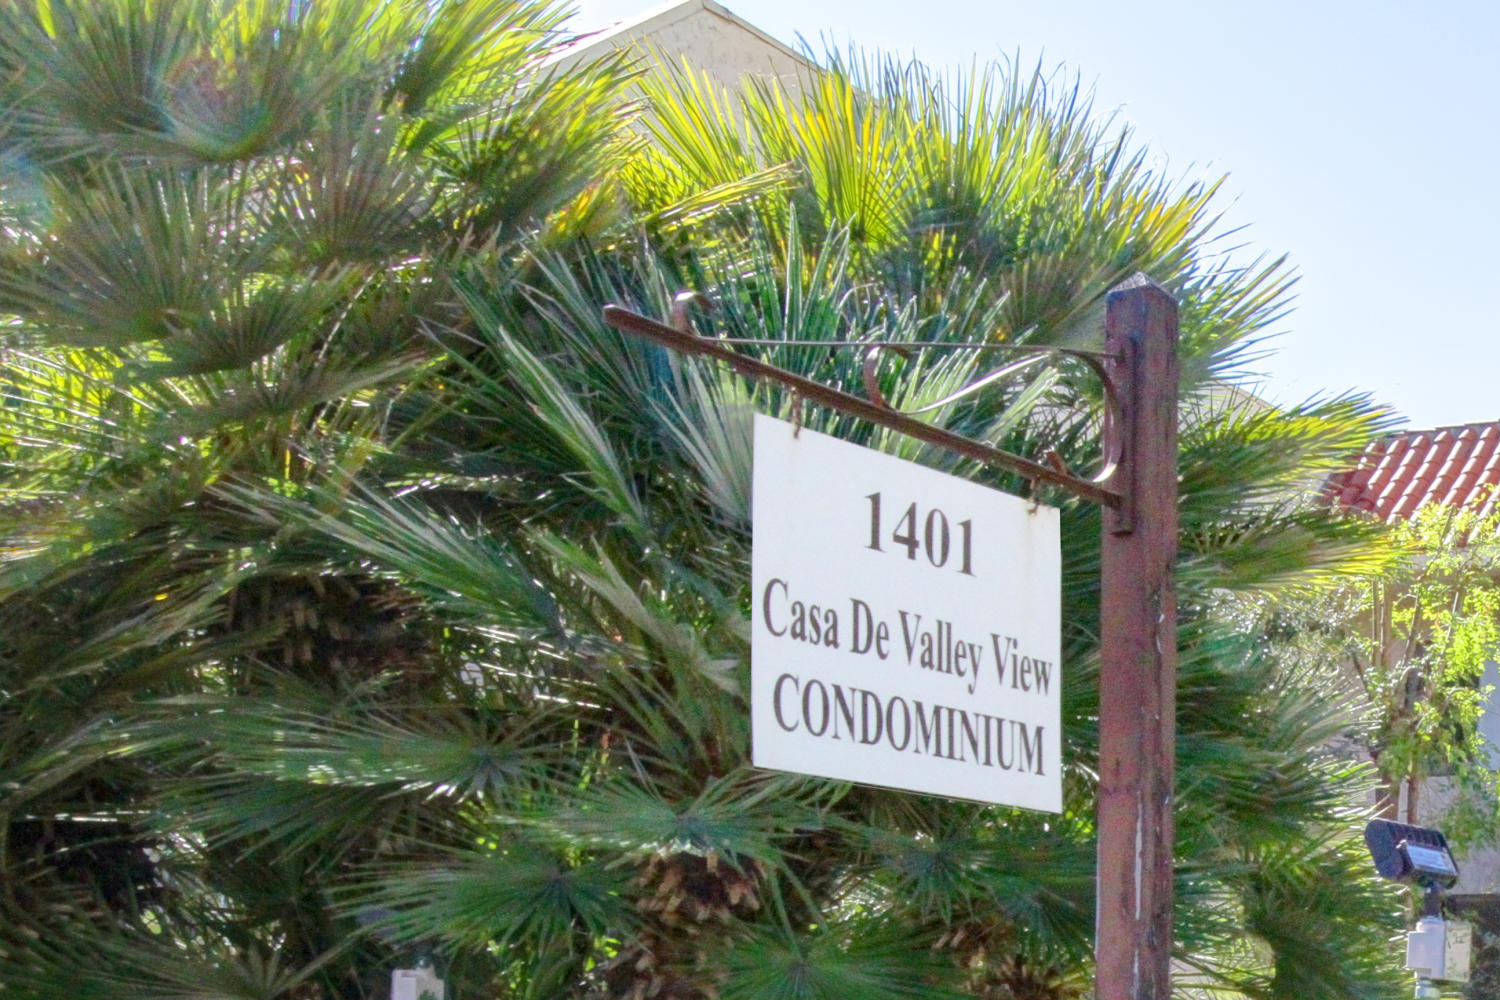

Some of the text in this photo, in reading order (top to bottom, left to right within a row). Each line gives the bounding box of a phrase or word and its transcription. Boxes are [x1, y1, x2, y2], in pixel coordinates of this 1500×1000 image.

[864, 491, 977, 577] 1401
[762, 578, 1053, 697] Casa De Valley View
[773, 672, 1046, 777] CONDOMINIUM
